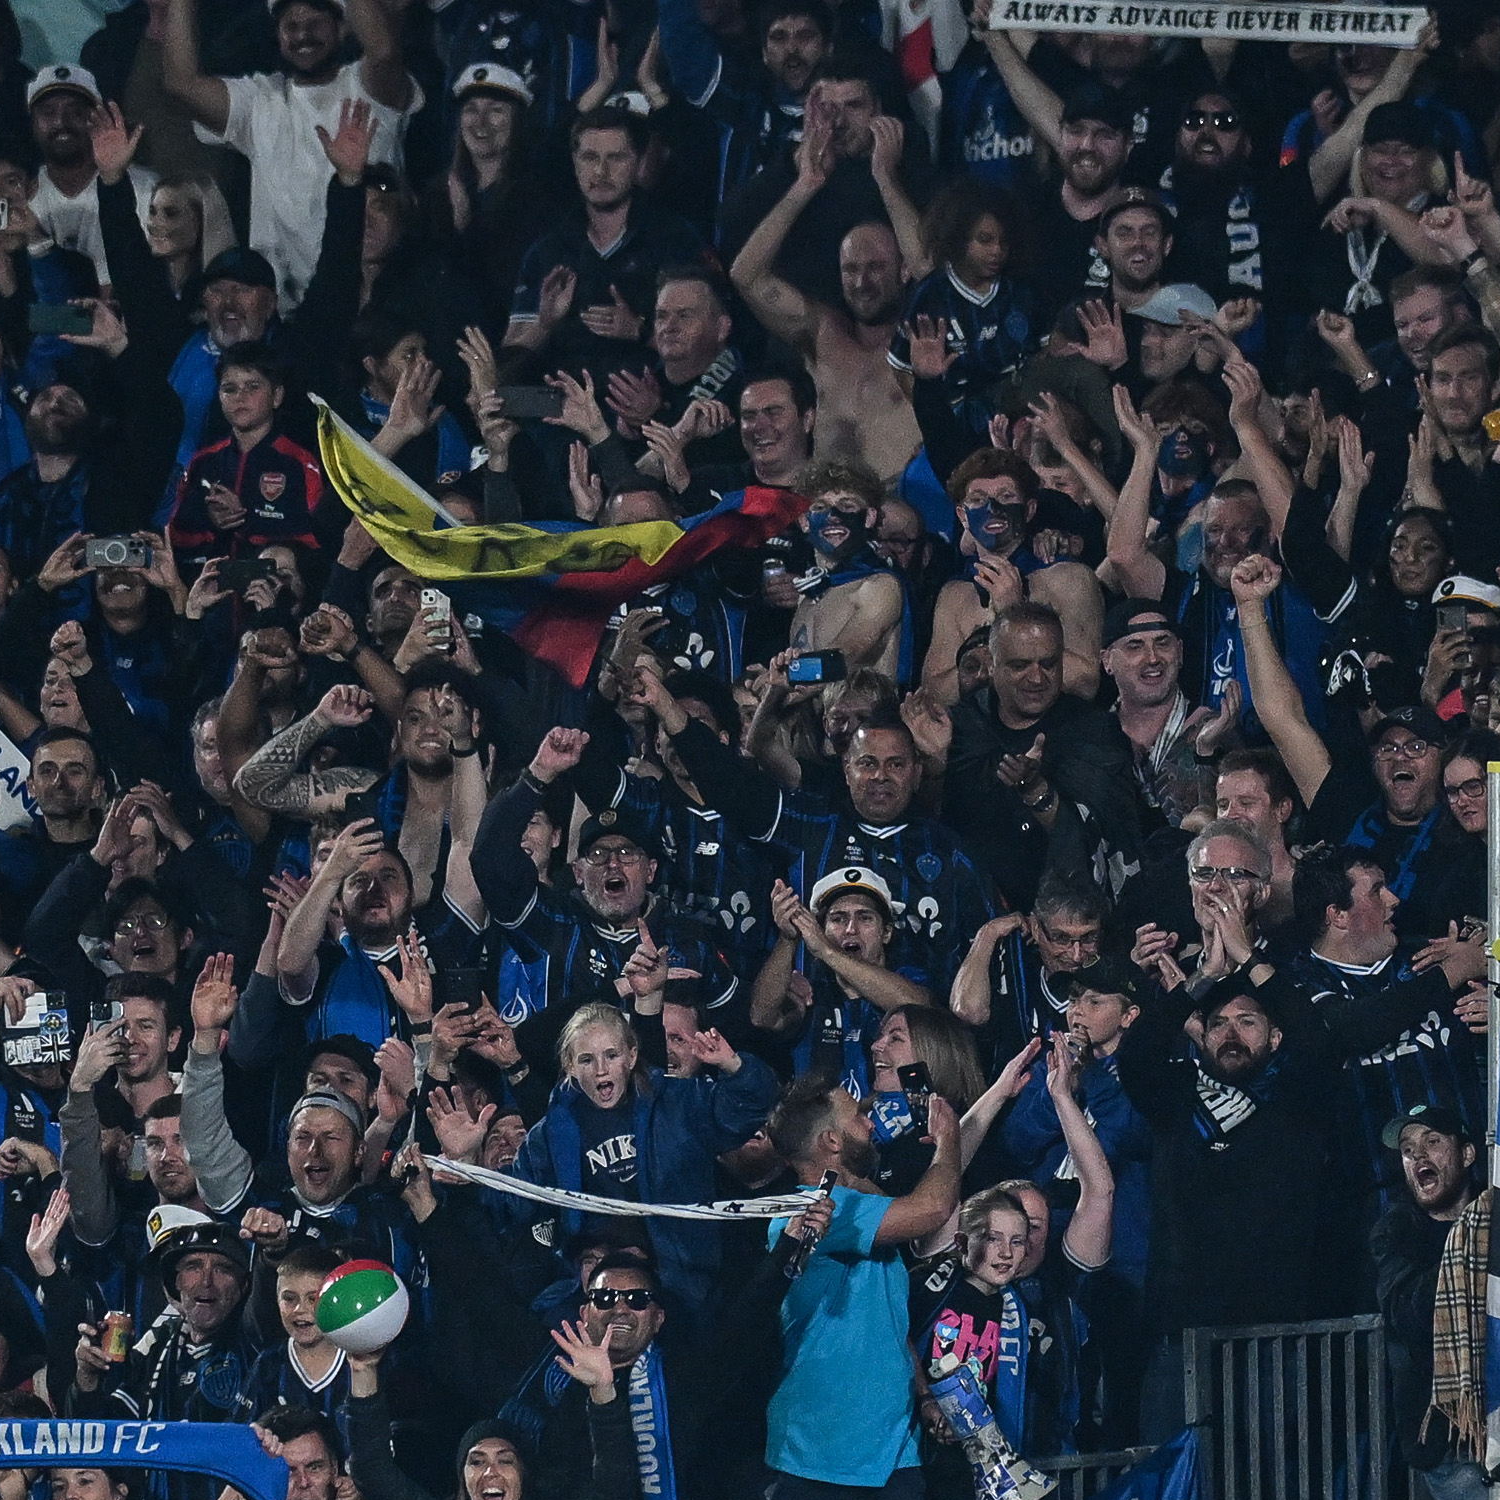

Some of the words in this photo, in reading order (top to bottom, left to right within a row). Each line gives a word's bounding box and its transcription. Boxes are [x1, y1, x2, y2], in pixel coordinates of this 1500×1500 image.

[1004, 1, 1103, 24] ALWAYS
[1108, 5, 1218, 29] ADVANCE
[1226, 9, 1301, 33] NEVER
[1309, 10, 1412, 35] RETREAT
[586, 1134, 638, 1176] NIK
[111, 1420, 165, 1454] FC
